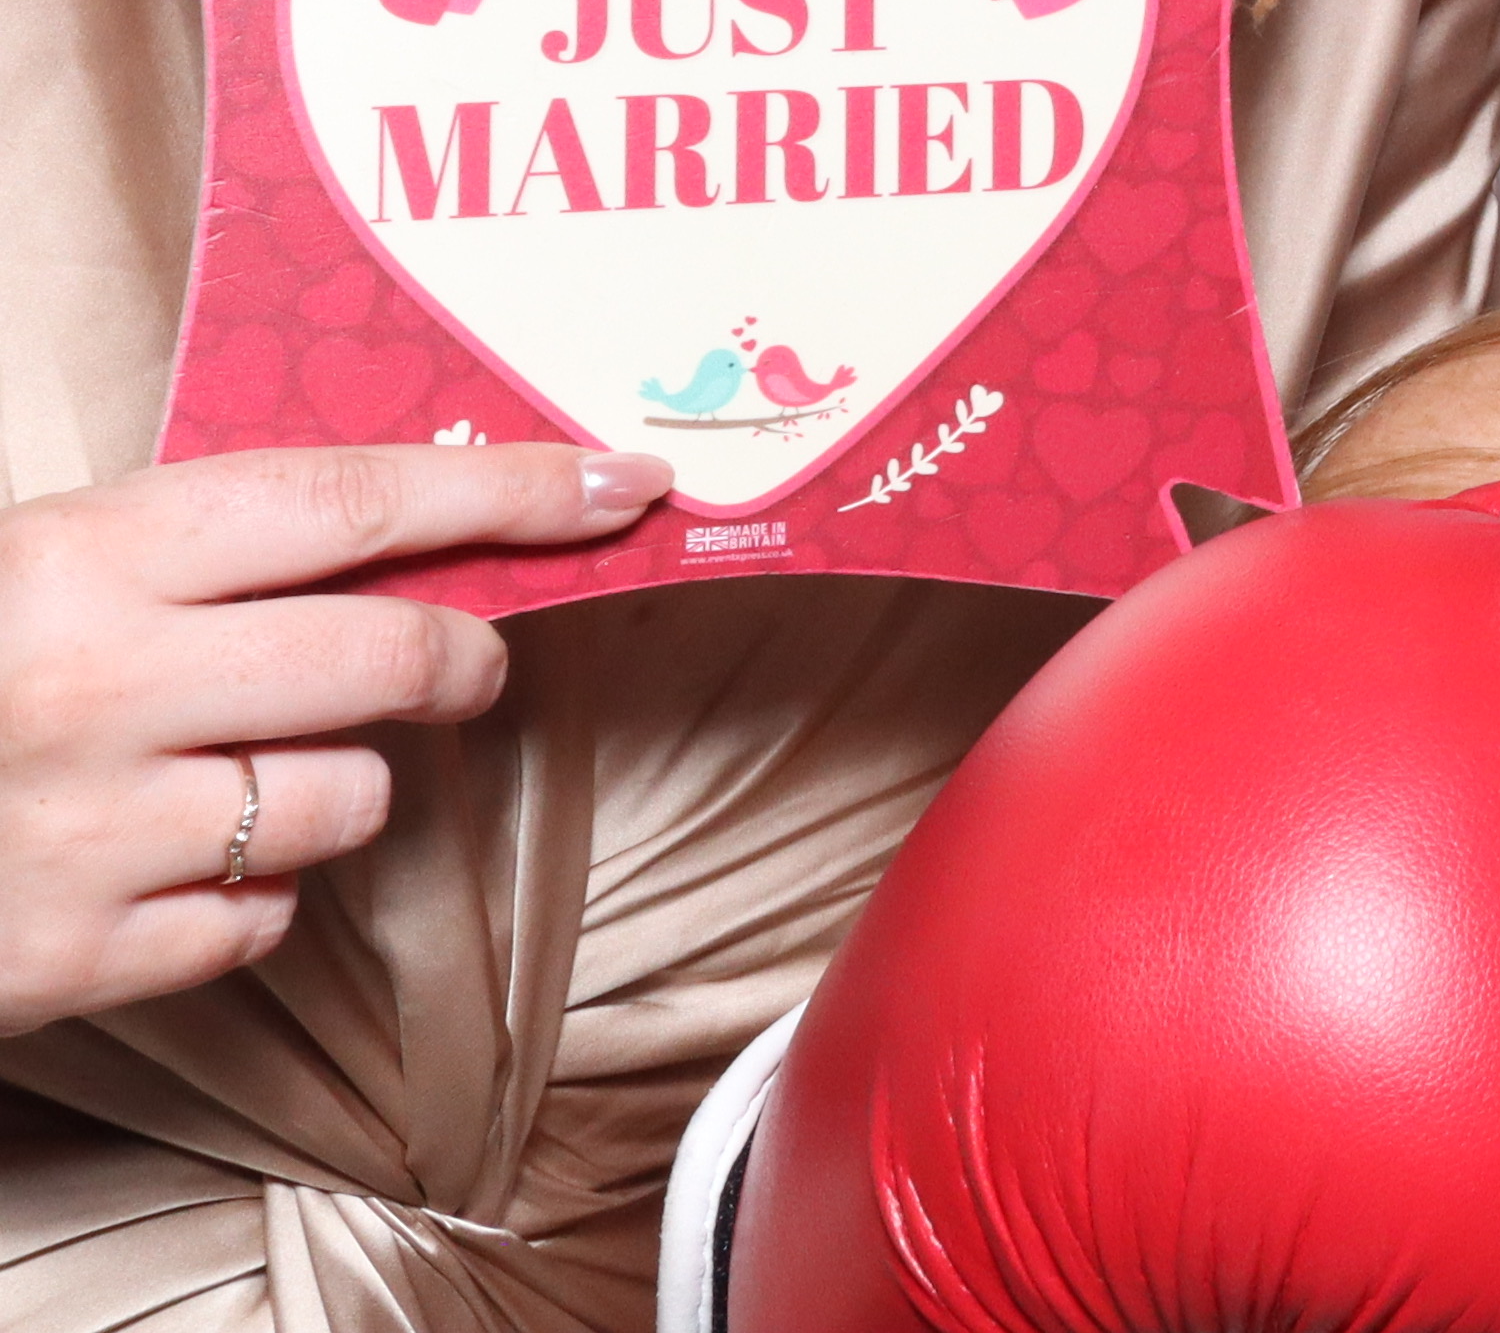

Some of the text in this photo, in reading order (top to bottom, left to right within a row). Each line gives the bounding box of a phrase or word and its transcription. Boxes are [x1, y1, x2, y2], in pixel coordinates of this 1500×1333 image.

[368, 79, 1085, 224] MARRIED
[728, 521, 786, 536] MADE IN
[728, 534, 786, 549] BRITAIN
